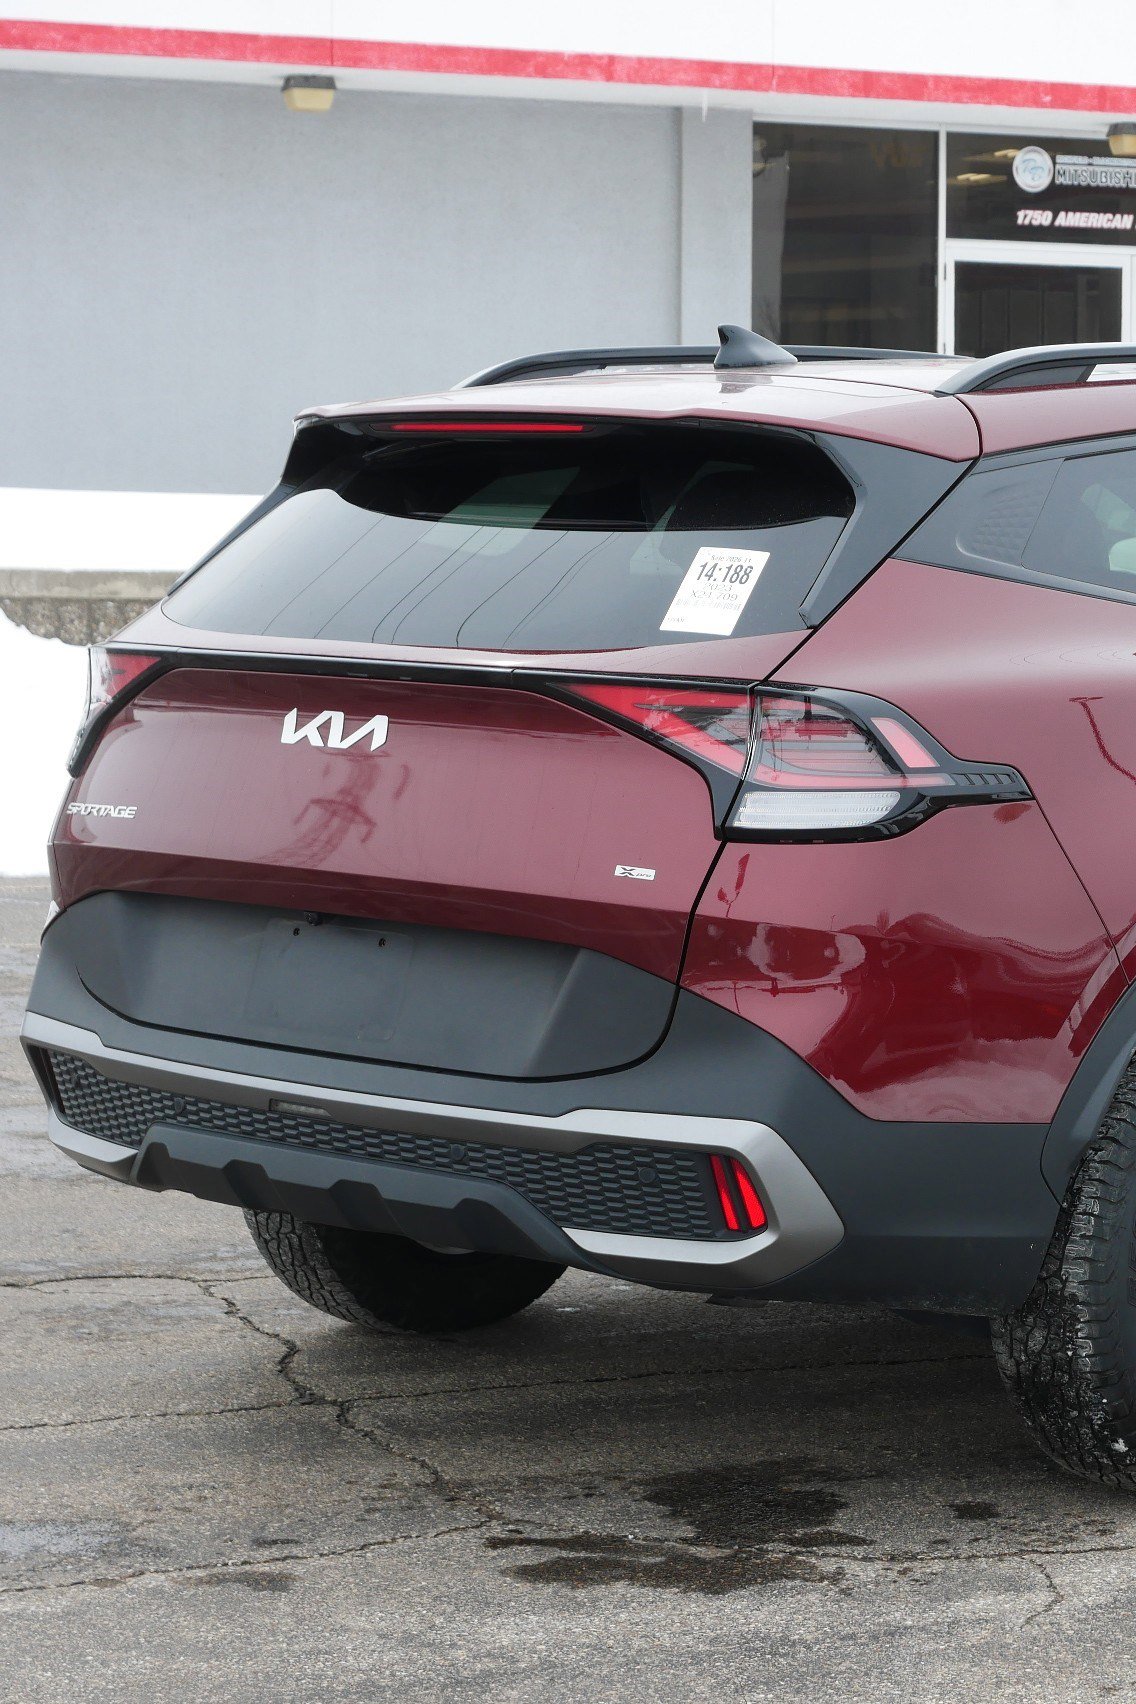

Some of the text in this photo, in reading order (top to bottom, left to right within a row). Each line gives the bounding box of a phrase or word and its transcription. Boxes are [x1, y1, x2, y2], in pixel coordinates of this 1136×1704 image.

[1017, 209, 1053, 226] 1750
[1054, 211, 1134, 230] AMERICAN
[697, 561, 754, 585] 14:188
[703, 583, 733, 592] 2023
[281, 707, 389, 752] KIA
[66, 803, 138, 819] SPORTAGE
